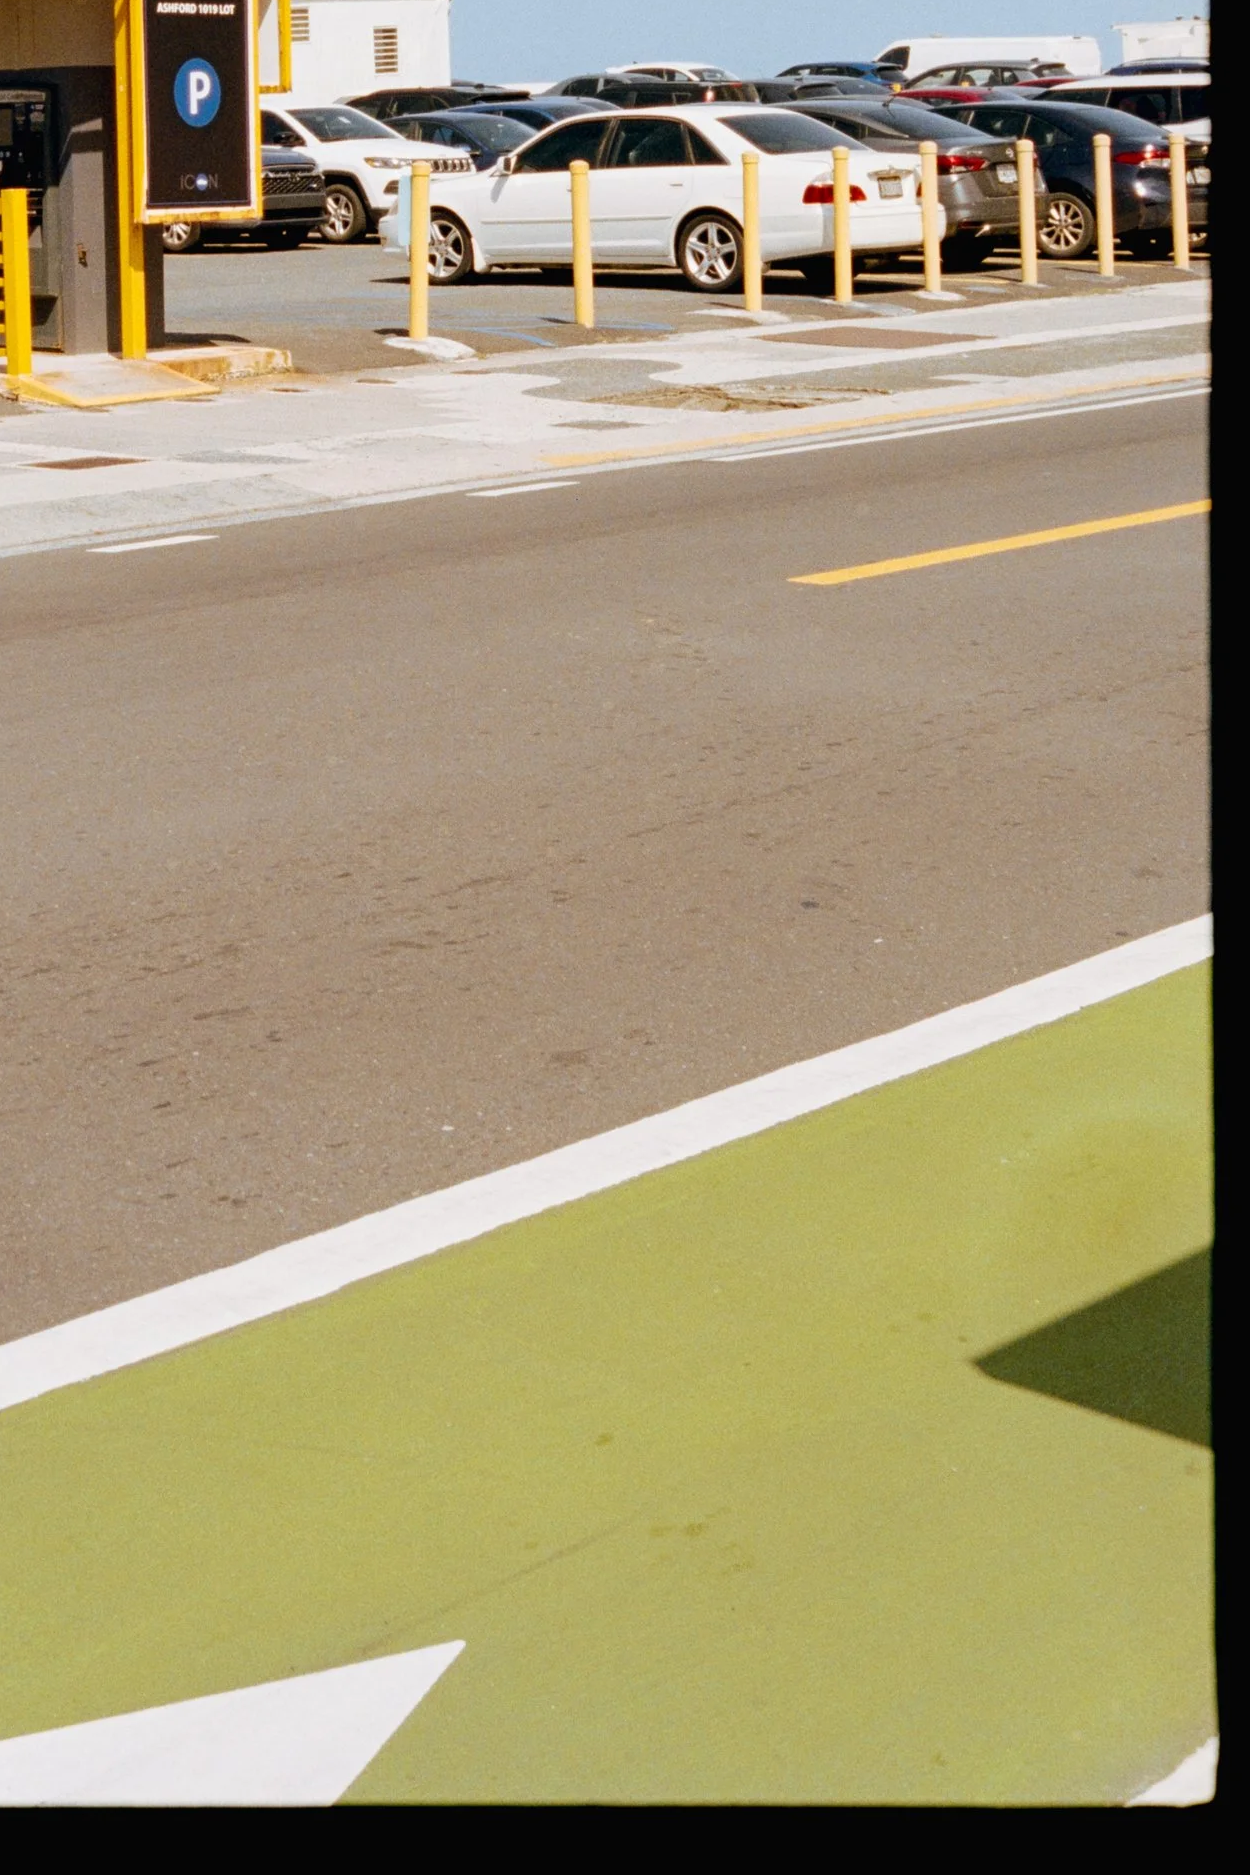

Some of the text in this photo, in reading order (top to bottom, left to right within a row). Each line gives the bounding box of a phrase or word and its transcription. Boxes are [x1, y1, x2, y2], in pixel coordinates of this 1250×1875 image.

[156, 2, 235, 15] ASHFORD 1019 LOT
[188, 71, 211, 115] P
